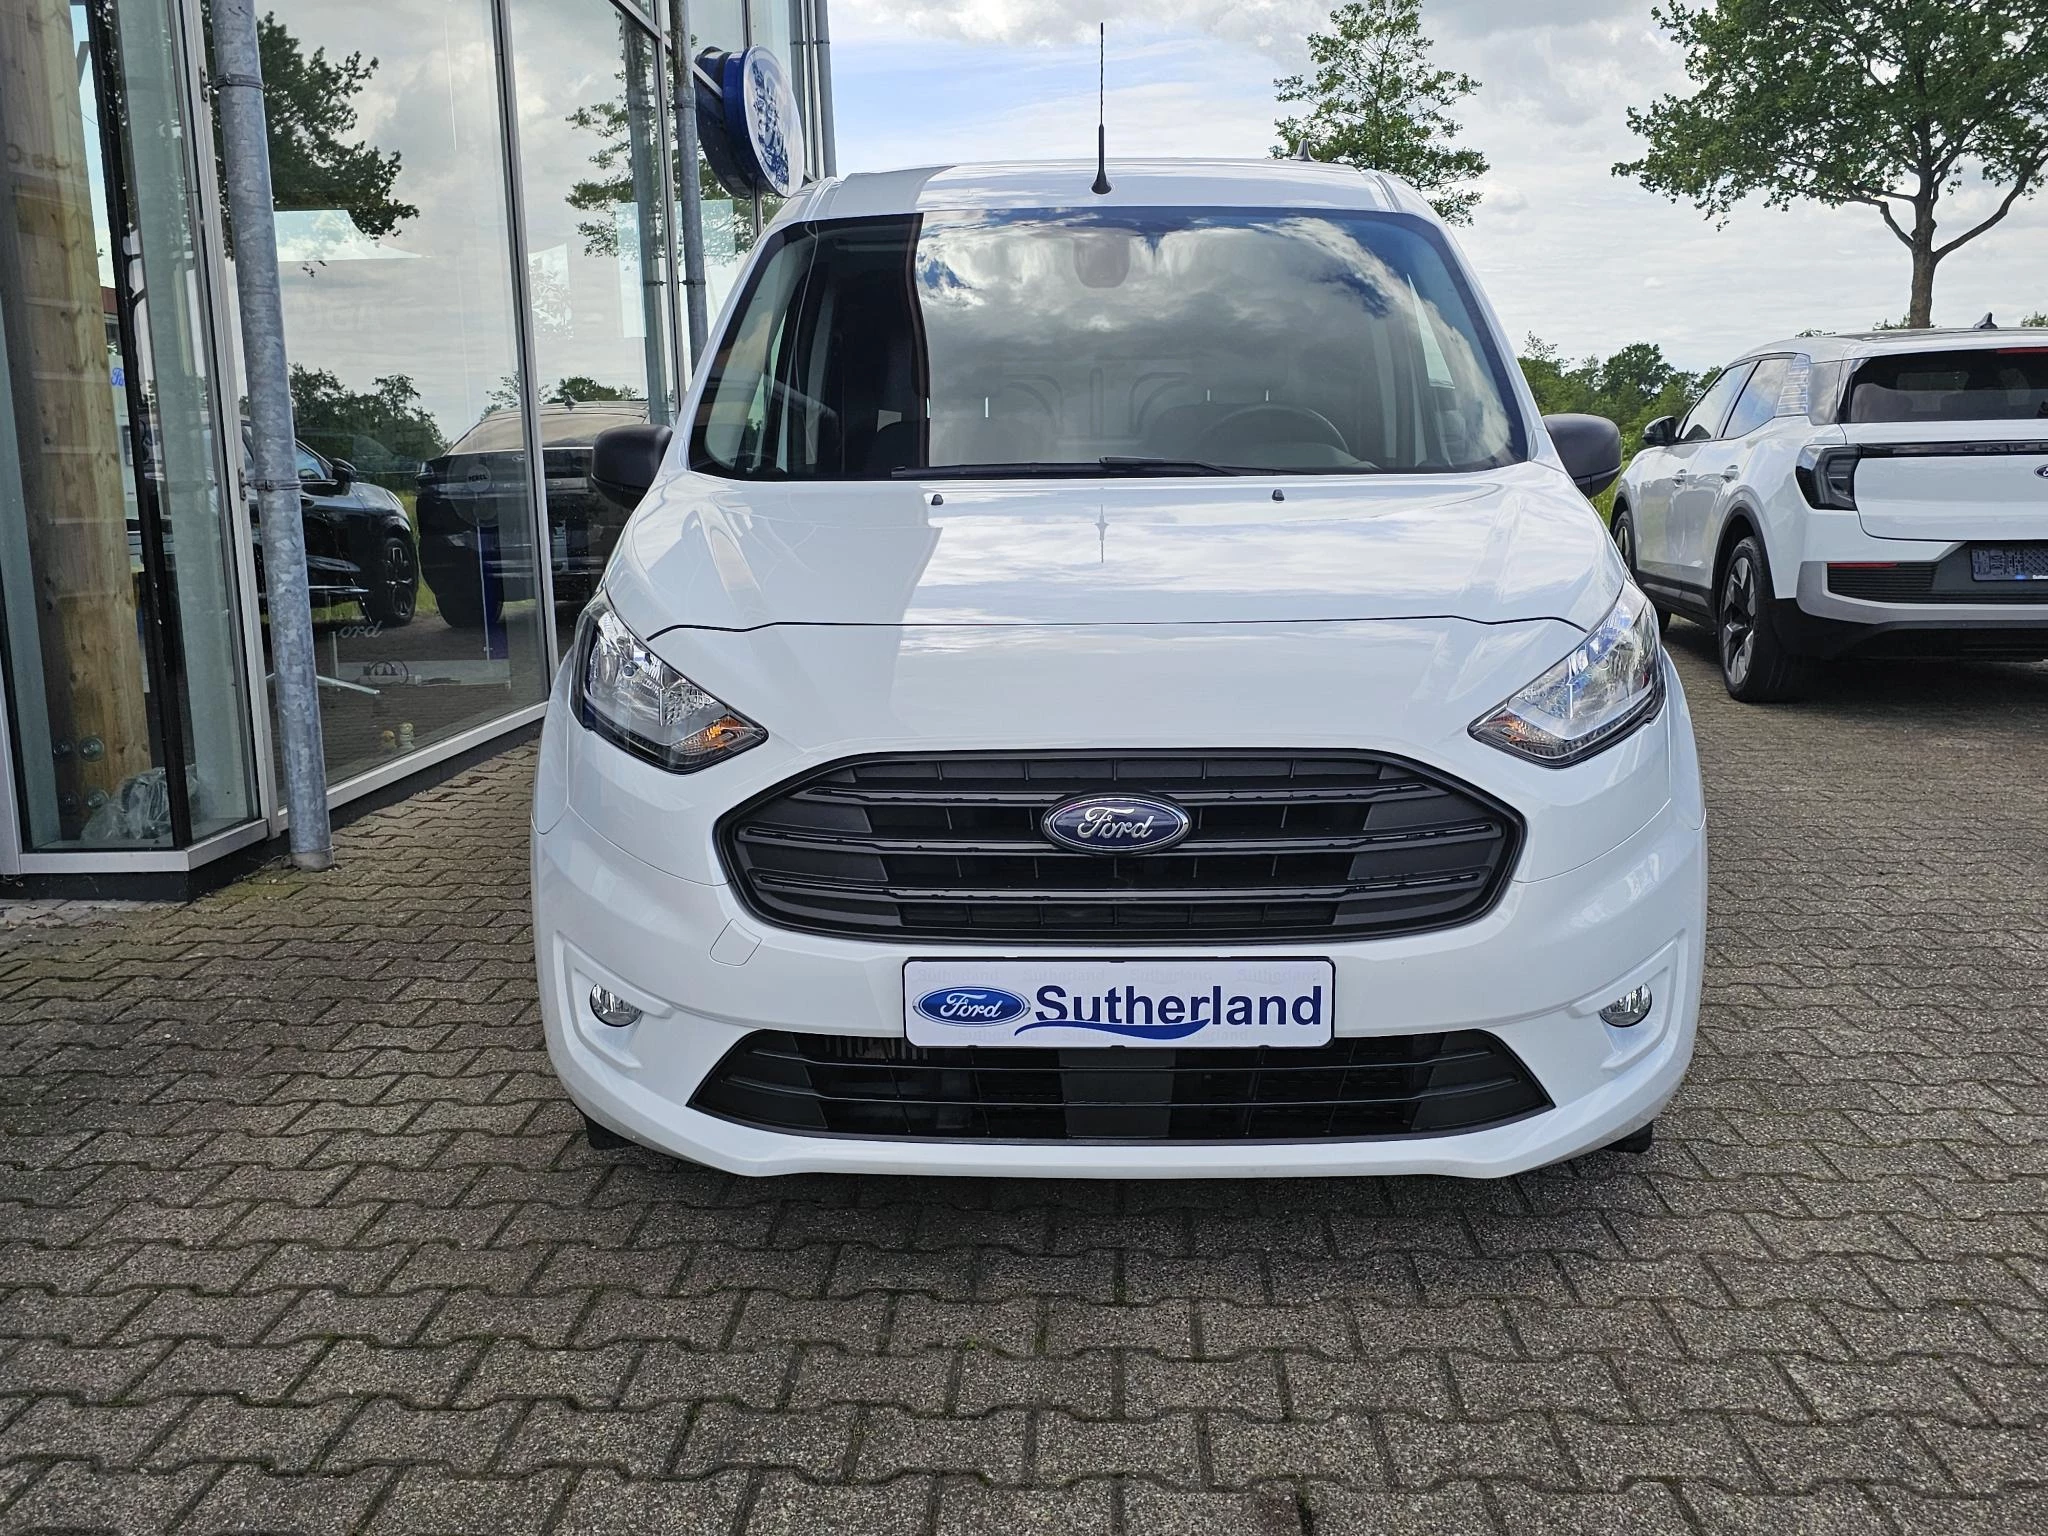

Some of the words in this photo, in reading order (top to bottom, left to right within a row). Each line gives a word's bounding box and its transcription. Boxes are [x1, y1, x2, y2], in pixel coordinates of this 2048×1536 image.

[1077, 806, 1153, 839] Ford
[940, 992, 1003, 1018] Ford
[1034, 985, 1322, 1026] Sutherland
